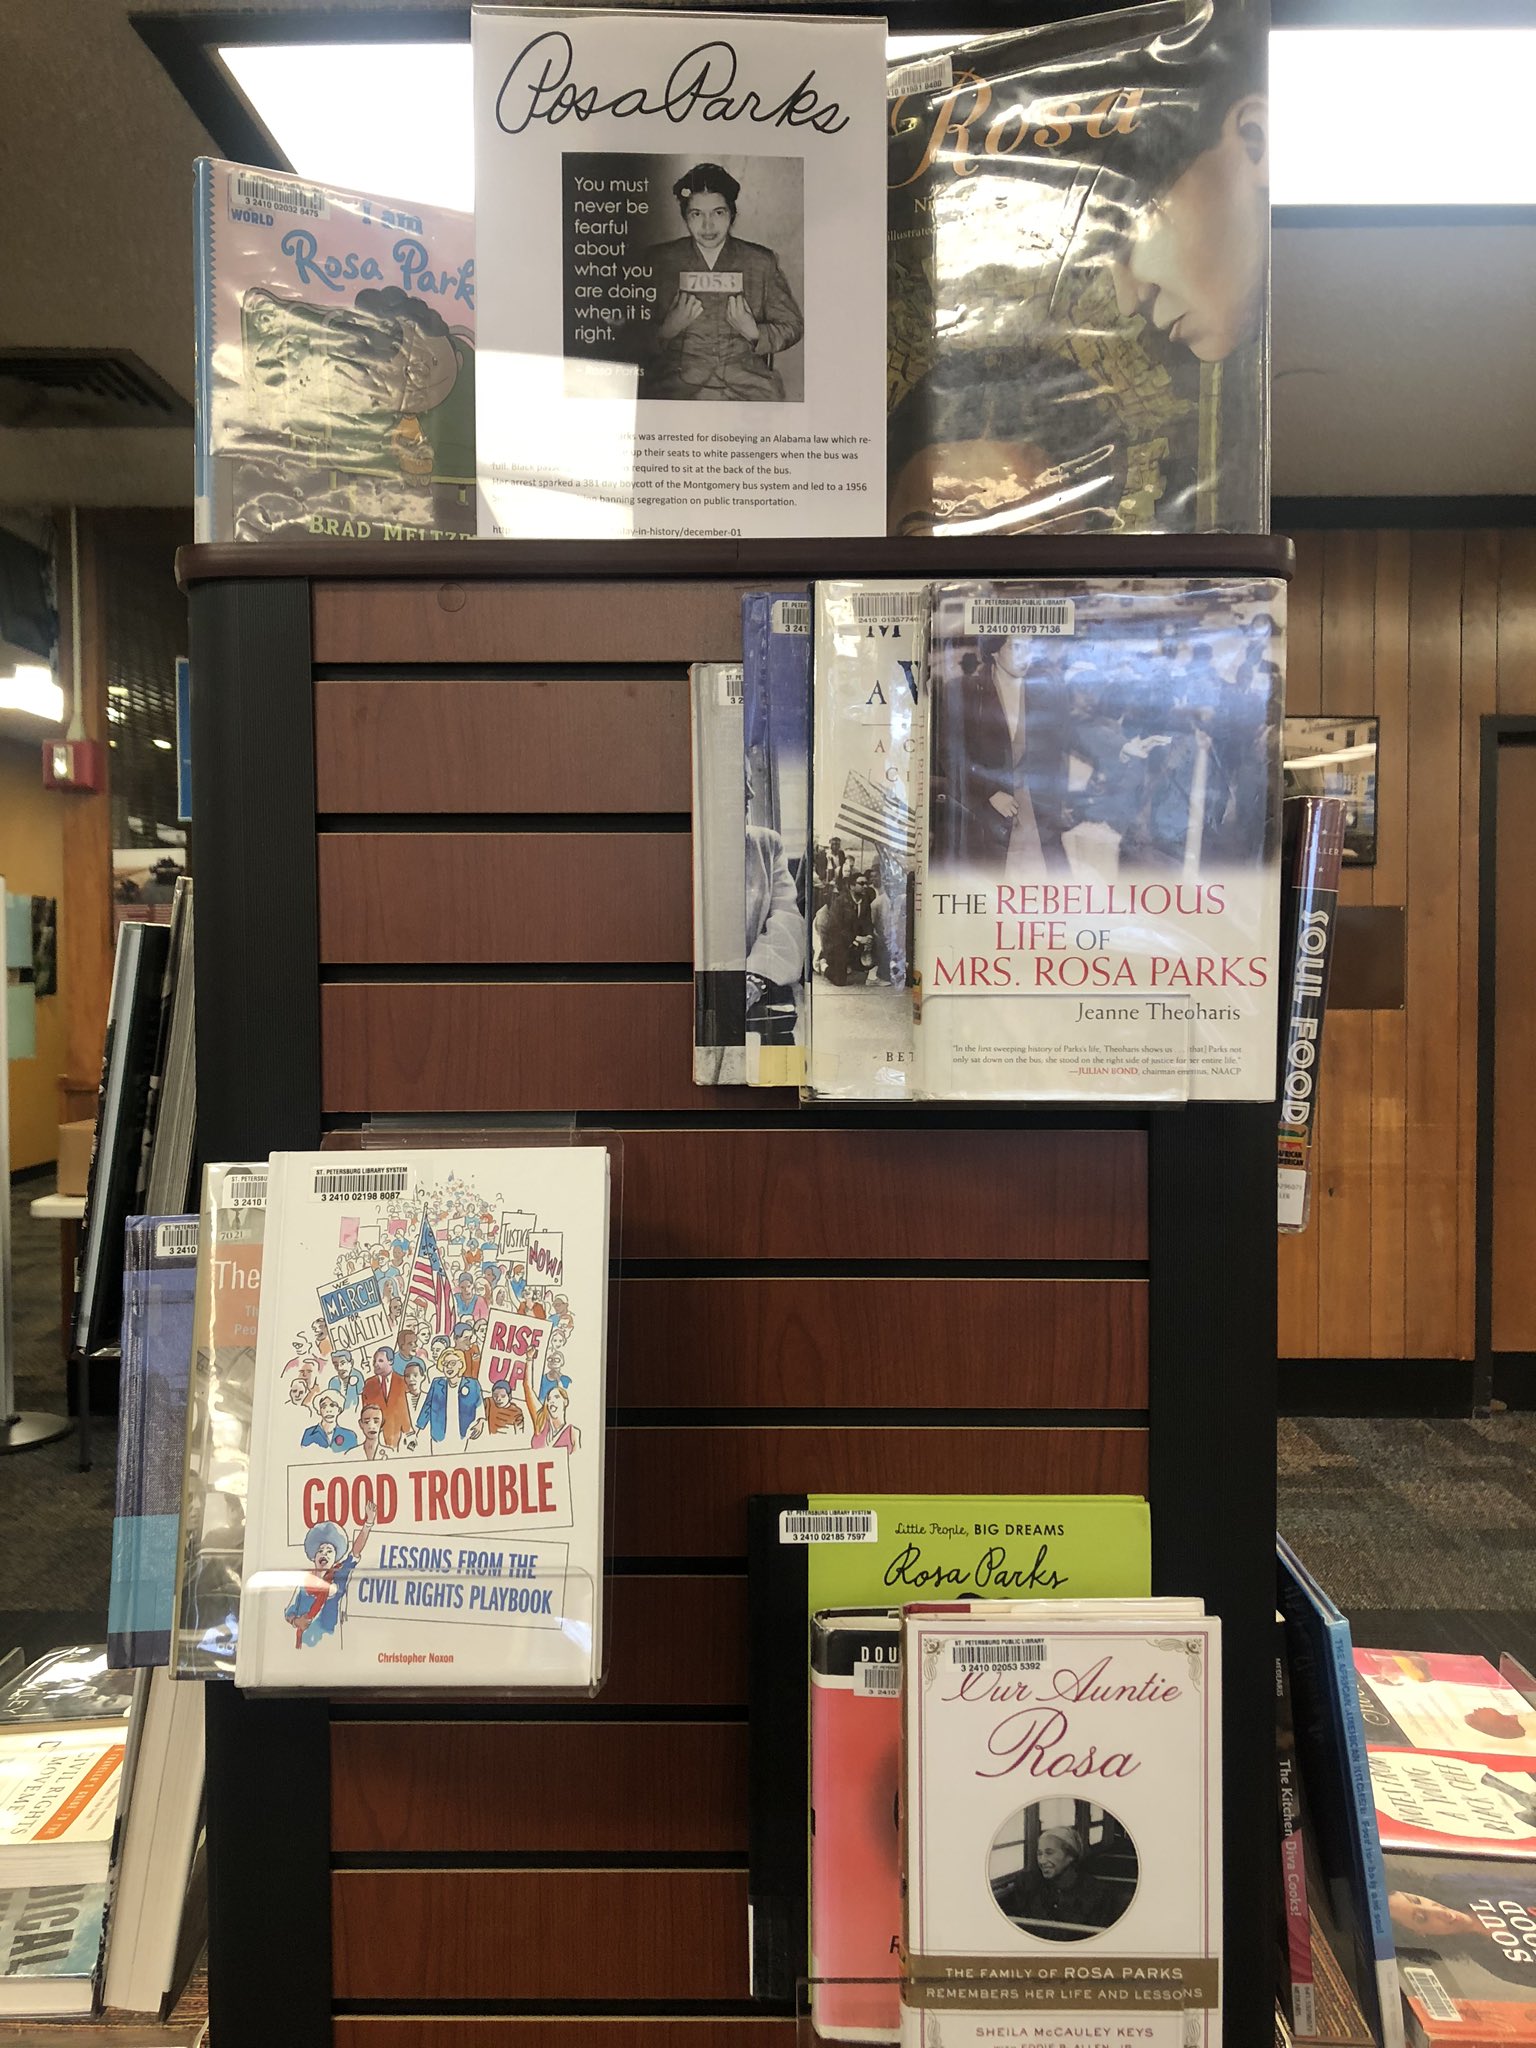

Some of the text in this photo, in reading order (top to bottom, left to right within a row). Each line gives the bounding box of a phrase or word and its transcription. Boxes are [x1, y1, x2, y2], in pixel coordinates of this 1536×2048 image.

[496, 31, 849, 133] Rosa Parks
[888, 67, 1144, 189] Rosa
[574, 177, 649, 192] You must
[231, 208, 274, 226] WORLD
[274, 203, 297, 213] 02032
[574, 200, 649, 214] never be
[384, 210, 423, 235] am
[574, 219, 628, 235] fearful
[574, 242, 626, 256] about
[281, 230, 474, 311] Rosa Park
[574, 262, 653, 284] what you
[688, 274, 736, 290] 7053
[574, 283, 657, 302] are doing
[574, 304, 650, 320] when it is
[575, 325, 616, 344] right.
[658, 433, 694, 442] arrested
[697, 434, 709, 442] for
[711, 434, 757, 445] disobeying
[773, 435, 811, 443] Alabama
[813, 435, 829, 443] law
[831, 436, 857, 444] which
[644, 449, 665, 457] their
[731, 452, 778, 460] passengers
[807, 451, 821, 459] the
[632, 465, 668, 475] required
[706, 466, 721, 474] the
[723, 466, 743, 474] back
[746, 466, 755, 474] of
[757, 466, 771, 474] the
[774, 467, 792, 475] bus.
[510, 479, 537, 487] arrest
[539, 478, 573, 488] sparked
[583, 479, 599, 487] 381
[619, 480, 652, 490] boycott
[655, 480, 665, 488] of
[667, 480, 681, 488] the
[683, 481, 740, 491] Montgomery
[743, 481, 757, 489] bus
[760, 482, 790, 491] system
[792, 482, 808, 490] and
[811, 482, 824, 491] led
[826, 483, 836, 491] to
[846, 483, 867, 491] 1956
[599, 496, 635, 506] banning
[637, 496, 687, 506] segregation
[704, 497, 730, 506] public
[732, 497, 797, 507] transportation.
[309, 515, 371, 538] BRAD
[987, 625, 1061, 633] 2410 01979 7136
[866, 680, 886, 704] A
[933, 884, 1226, 915] THE REBELLIOUS
[996, 921, 1110, 951] LIFE OF
[933, 957, 1267, 988] MRS. ROSA PARKS
[1075, 1003, 1241, 1022] Jeanne Theoharis
[1282, 910, 1330, 1125] SOUL FOOD
[329, 1192, 401, 1201] 2410 02198 8087
[220, 1231, 243, 1240] 7021
[529, 1240, 563, 1284] NOW!
[212, 1260, 260, 1290] The
[332, 1278, 350, 1289] WE
[324, 1279, 378, 1320] MARCH
[347, 1312, 361, 1322] FOR
[330, 1311, 386, 1350] EQUALITY
[490, 1321, 543, 1359] RISE
[488, 1356, 526, 1391] UP
[303, 1461, 557, 1528] GOOD TROUBLE
[895, 1522, 1065, 1539] Little People, BIG DREAMS
[379, 1544, 538, 1579] LESSONS FROM THE
[884, 1543, 1068, 1589] Rosa Parks
[358, 1578, 553, 1614] CIVIL RIGHTS PLAYBOOK
[377, 1652, 454, 1665] Christopher Noxon
[969, 1664, 989, 1672] 2410
[992, 1663, 1017, 1672] 02053
[941, 1656, 1183, 1703] Our Auntie
[975, 1706, 1141, 1778] Rosa
[7, 1756, 68, 1815] MOVEME
[11, 1786, 65, 1834] RIGHTS
[1279, 1758, 1302, 1916] The Kitchen Diva Cooks!
[1469, 1899, 1533, 1963] SOUL
[945, 1967, 1183, 1979] THE FAMILY OF ROSA PARKS
[926, 1987, 1203, 2000] REMEMBERS HER LIFE AND LESSONS
[976, 2027, 1154, 2038] SHEILA McCAULEY KEYS
